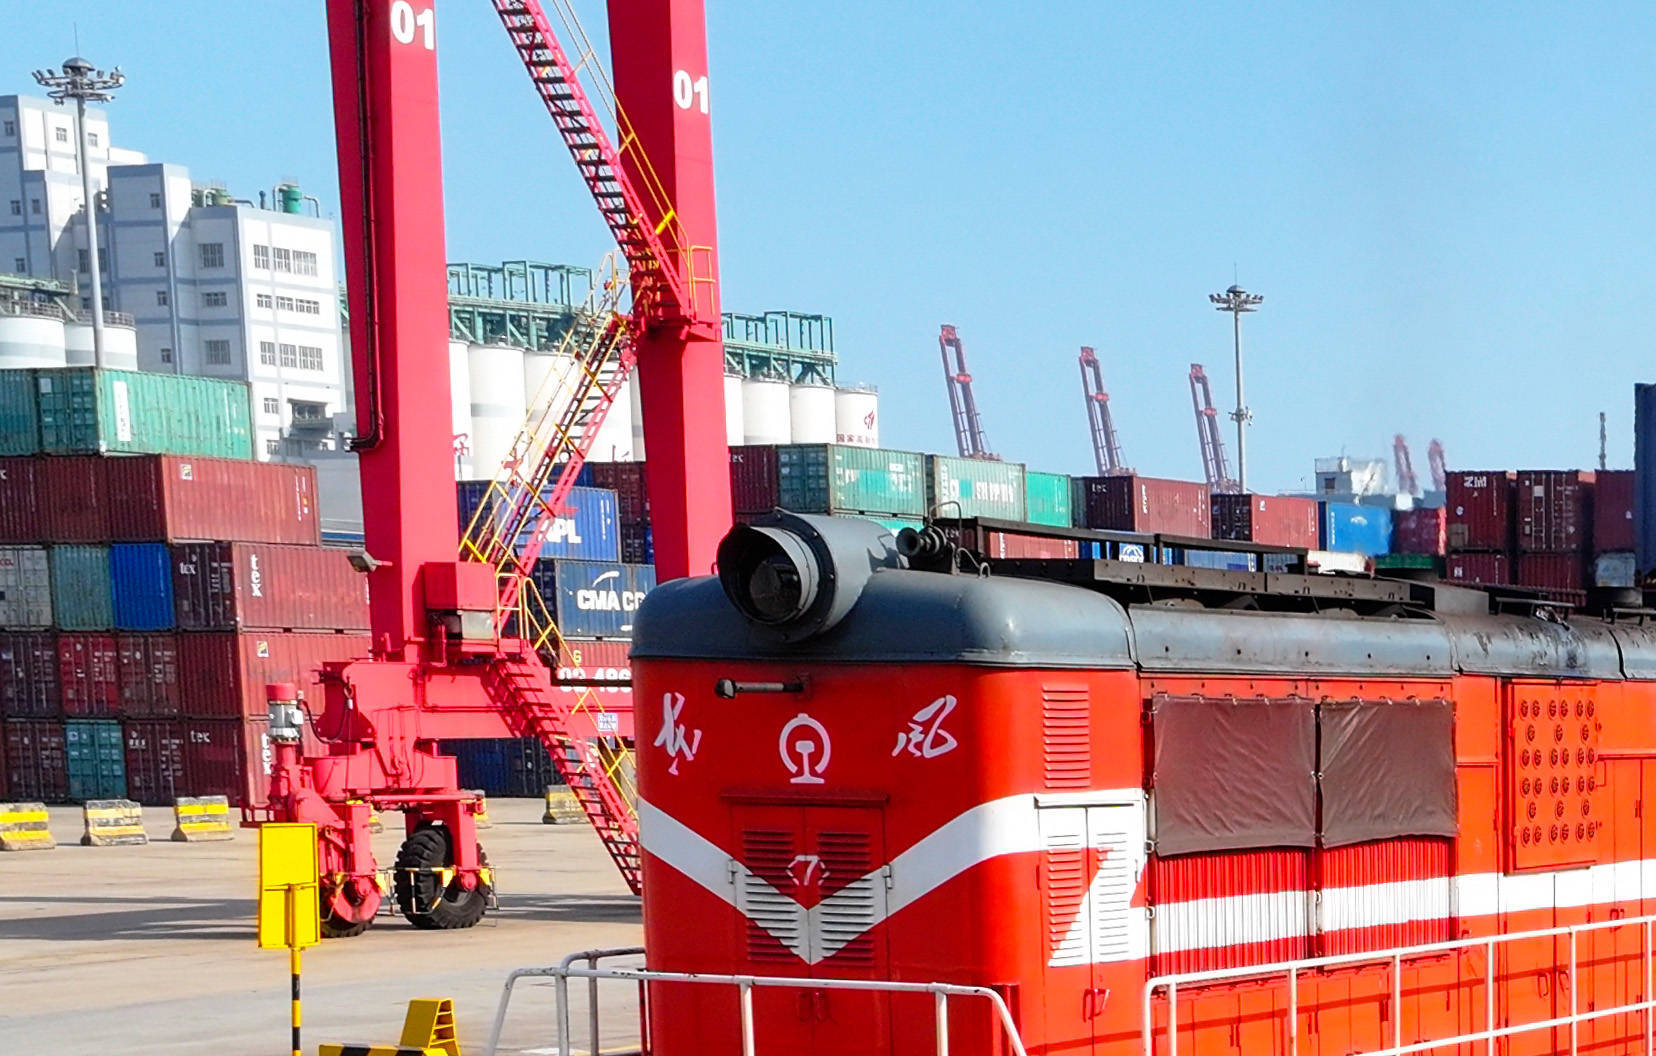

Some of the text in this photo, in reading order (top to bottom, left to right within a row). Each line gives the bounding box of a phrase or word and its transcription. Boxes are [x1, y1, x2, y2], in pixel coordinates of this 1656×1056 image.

[391, 1, 434, 50] 01
[673, 70, 709, 114] 01
[251, 554, 263, 597] tex
[577, 589, 621, 611] CMA
